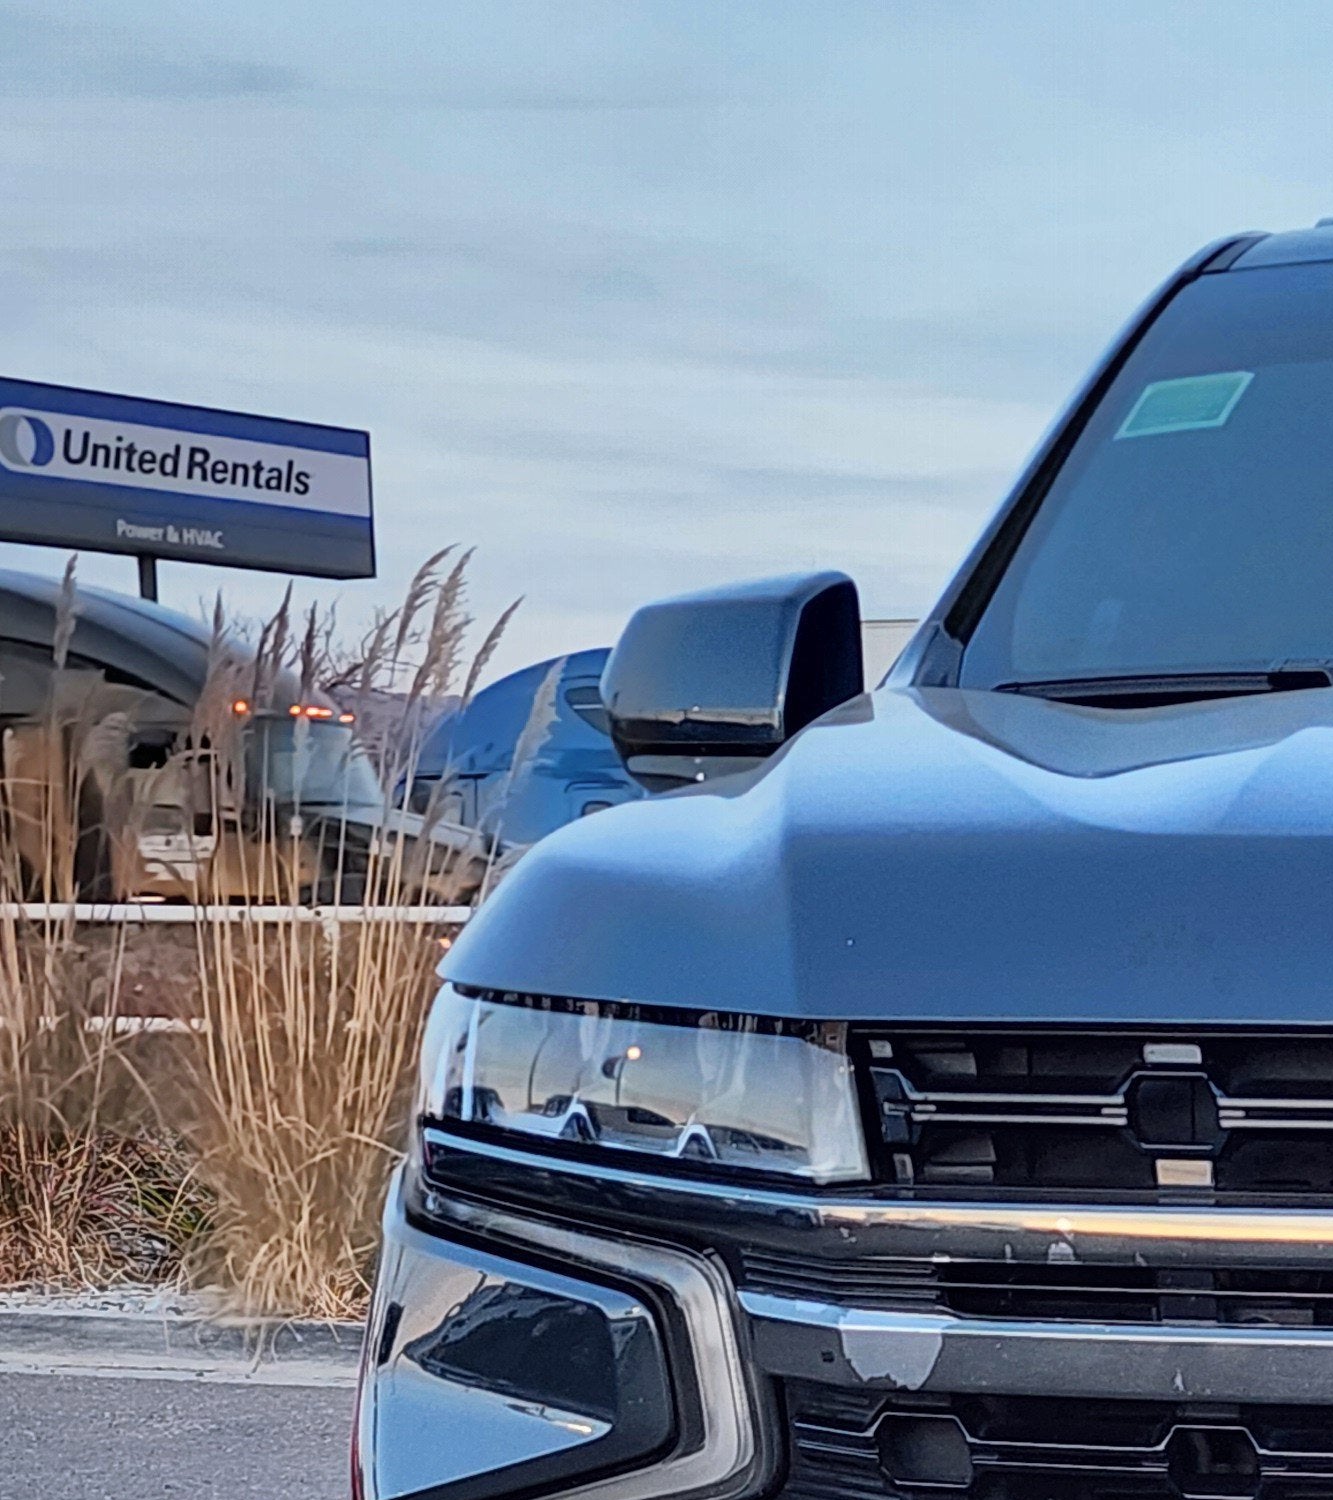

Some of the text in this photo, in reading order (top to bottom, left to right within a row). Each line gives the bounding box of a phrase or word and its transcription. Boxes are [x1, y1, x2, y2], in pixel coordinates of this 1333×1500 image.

[62, 428, 311, 496] United Rentals
[116, 518, 225, 549] Power & HVAC
